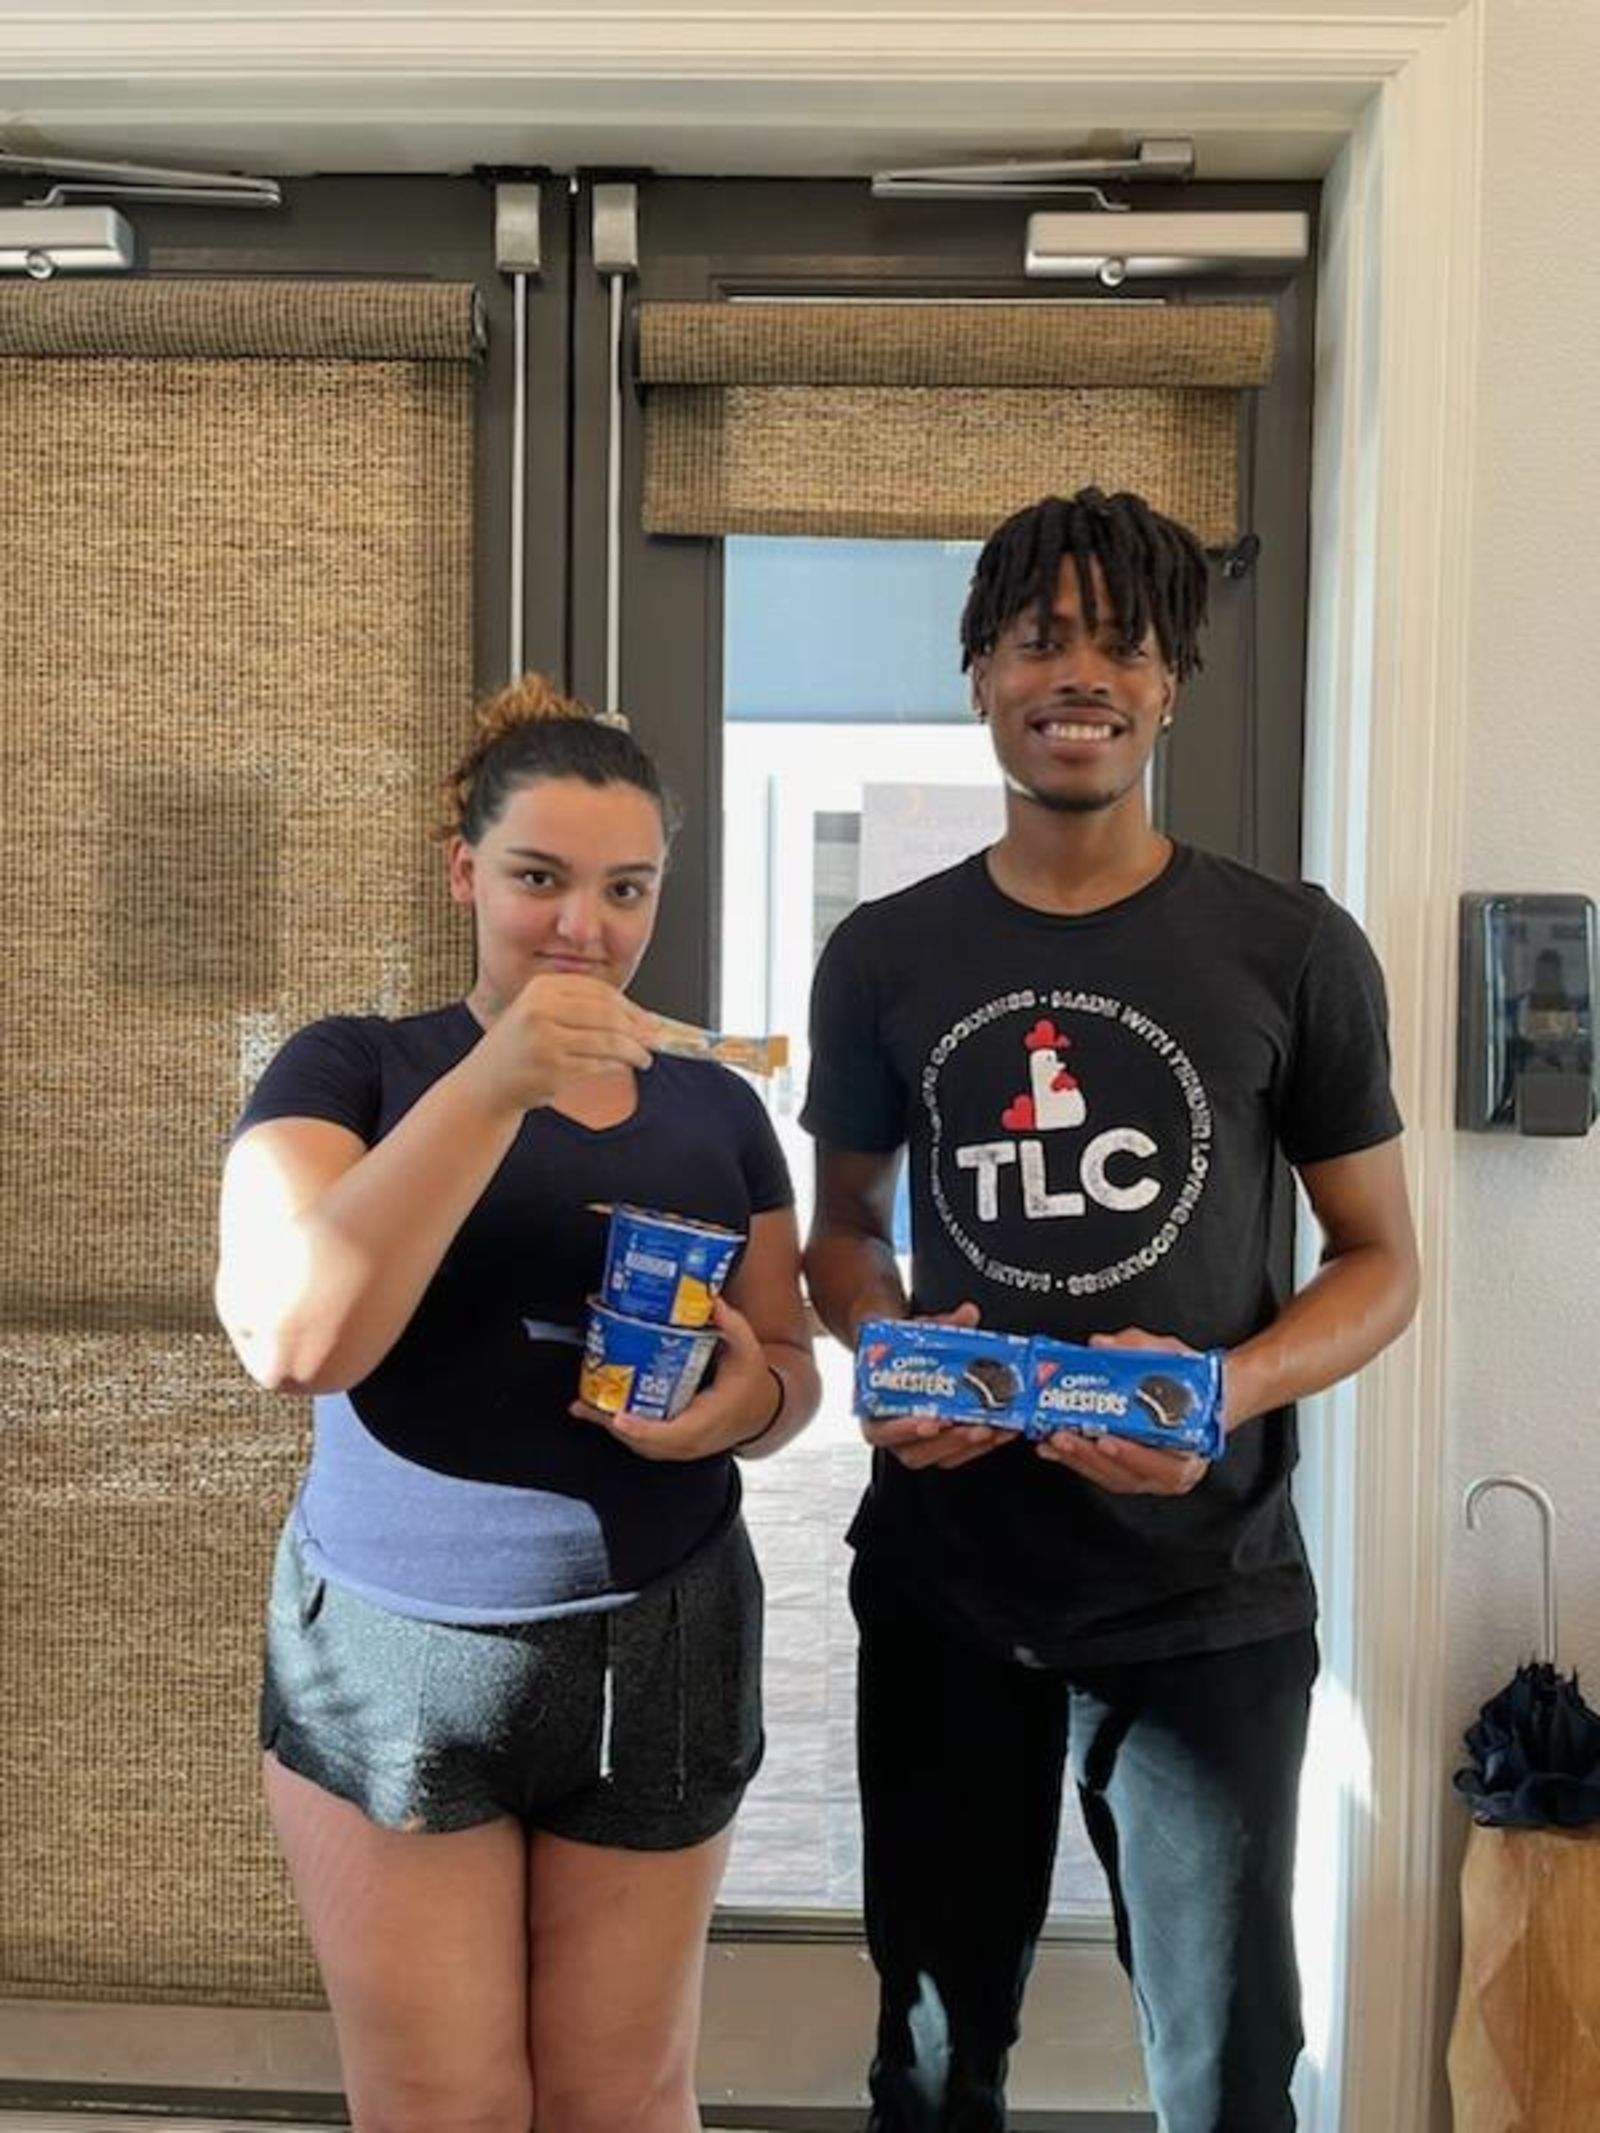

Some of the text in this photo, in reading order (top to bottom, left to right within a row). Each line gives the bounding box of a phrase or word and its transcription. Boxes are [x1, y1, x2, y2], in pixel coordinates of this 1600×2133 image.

[1051, 990, 1120, 1016] MADE
[1121, 1008, 1174, 1056] WITH
[955, 1126, 1162, 1222] TLC
[1177, 1144, 1212, 1226] LOVING
[1067, 1224, 1179, 1296] GOODNESS
